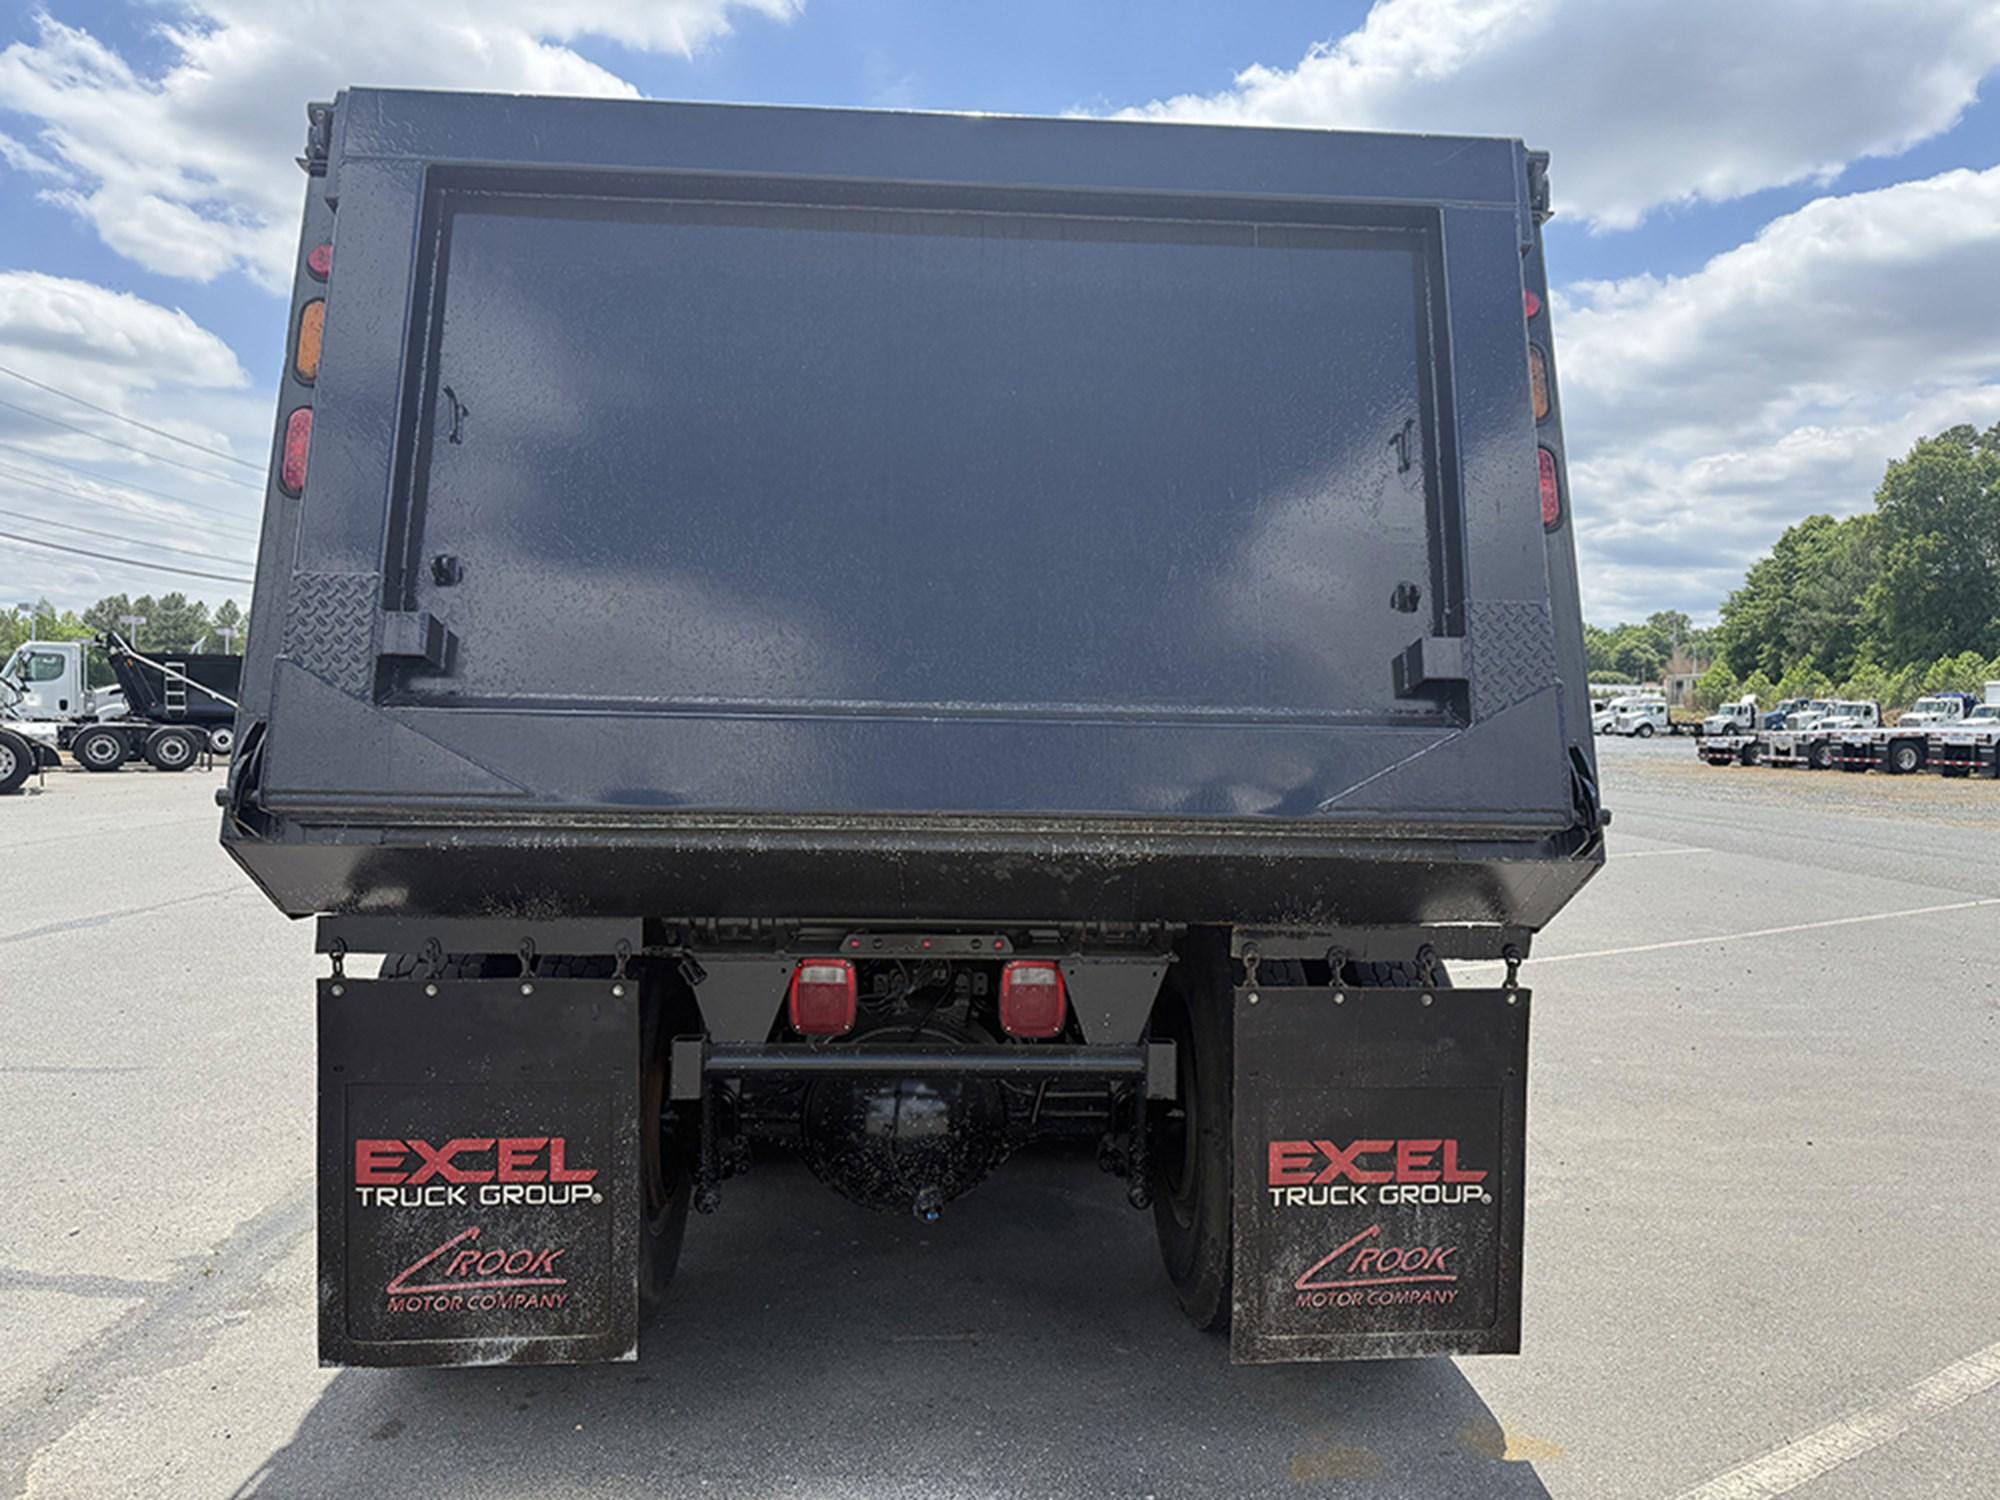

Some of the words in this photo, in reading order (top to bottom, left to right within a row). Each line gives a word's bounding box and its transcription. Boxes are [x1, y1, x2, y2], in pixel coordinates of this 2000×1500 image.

[355, 1138, 598, 1184] EXCEL
[1268, 1139, 1489, 1185] EXCEL
[355, 1186, 467, 1207] TRUCK
[1268, 1186, 1368, 1207] TRUCK
[386, 1297, 463, 1313] MOTOR
[467, 1294, 568, 1310] COMPANY
[1295, 1291, 1362, 1308] MOTOR
[1366, 1289, 1458, 1306] COMPANY
